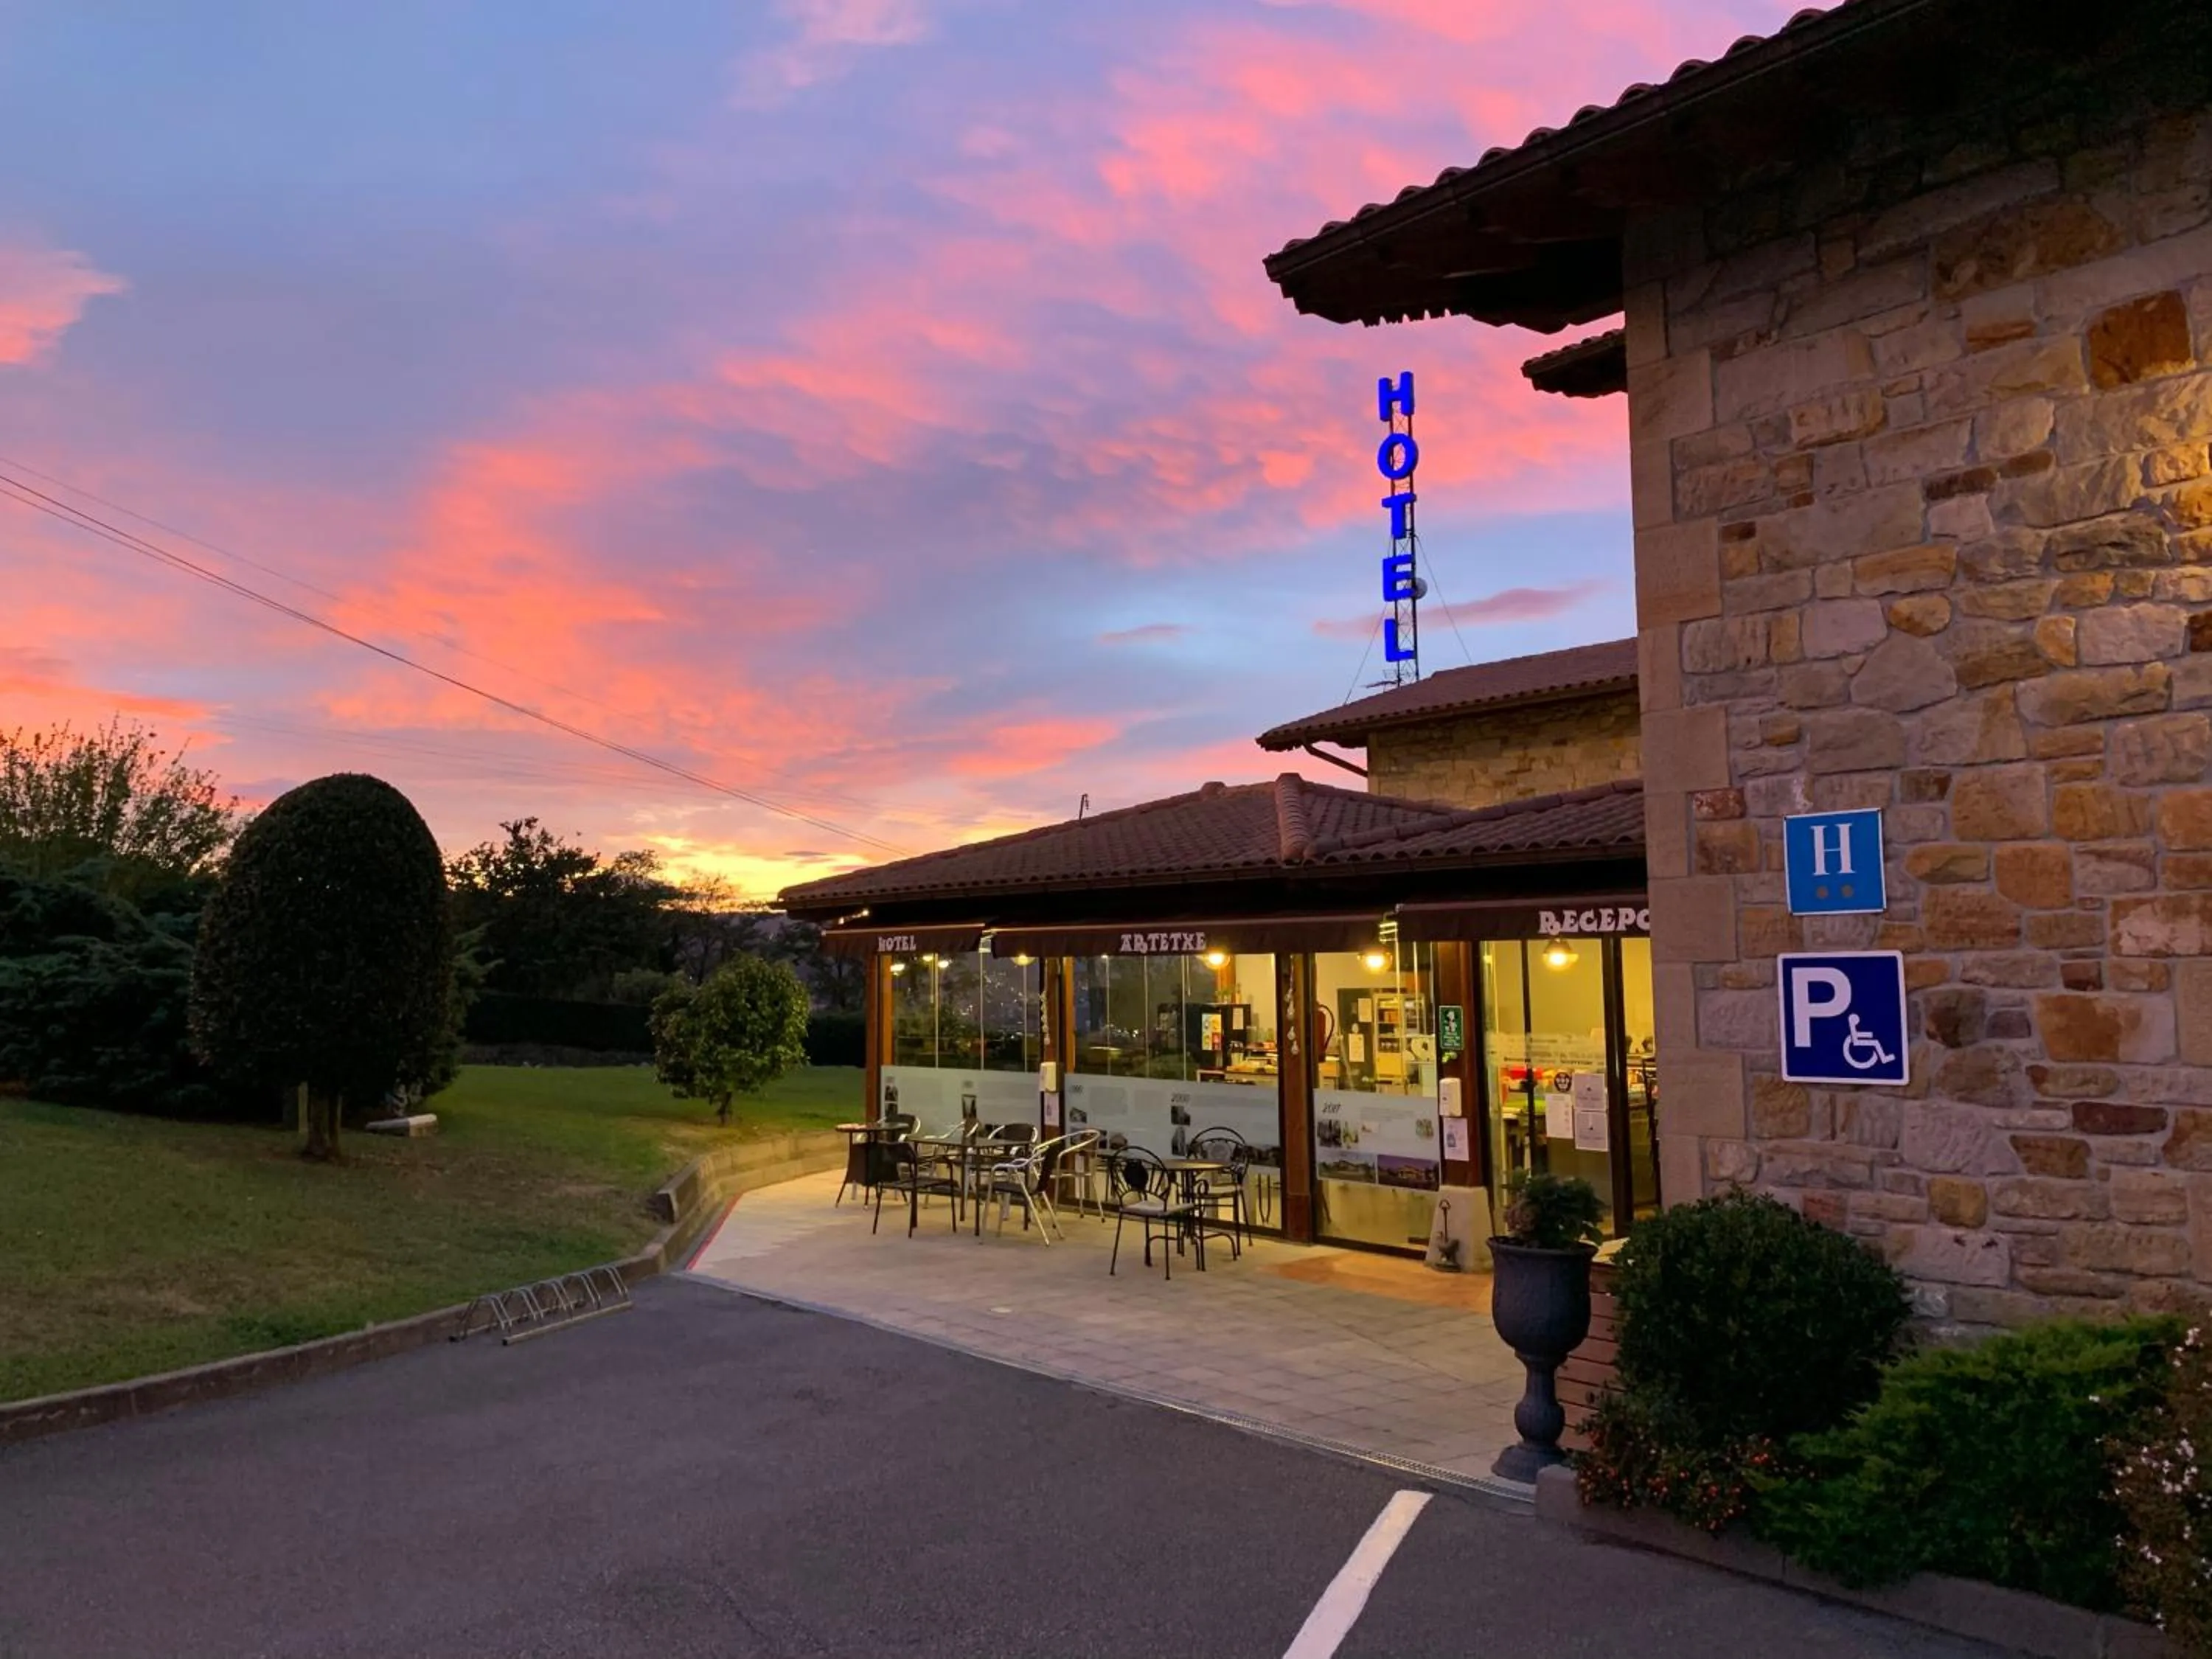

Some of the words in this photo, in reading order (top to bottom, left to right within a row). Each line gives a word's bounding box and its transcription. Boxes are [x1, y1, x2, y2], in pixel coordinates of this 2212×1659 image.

[1377, 372, 1418, 662] HOTEL
[1810, 823, 1855, 876] H
[878, 935, 917, 952] HOTEL
[1121, 932, 1206, 953] ARTETXE
[1792, 967, 1851, 1048] P
